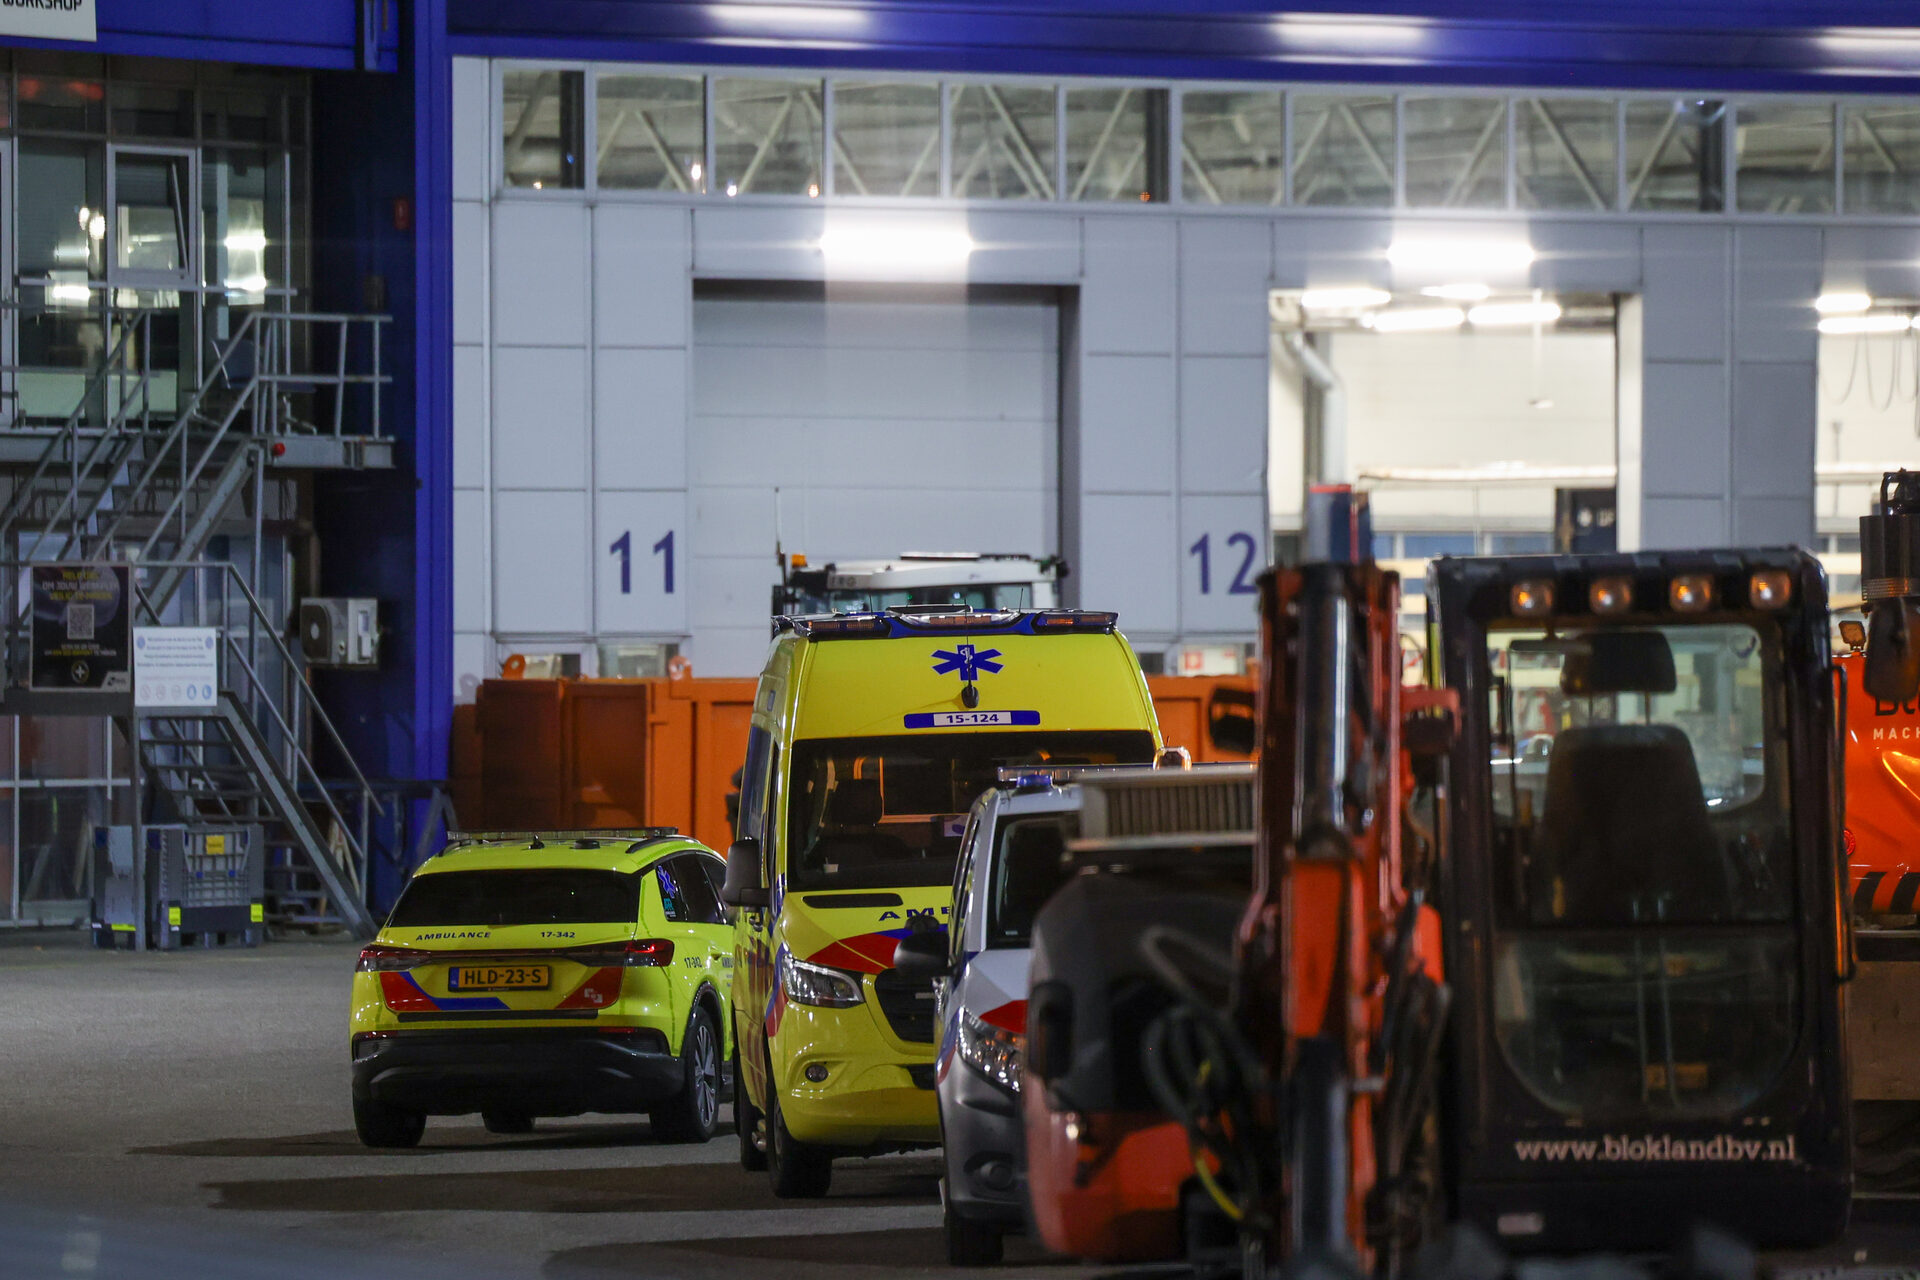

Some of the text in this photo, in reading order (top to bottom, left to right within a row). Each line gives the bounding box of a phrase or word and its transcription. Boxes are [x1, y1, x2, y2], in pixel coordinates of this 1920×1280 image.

[610, 530, 674, 594] 11
[1190, 531, 1258, 594] 12
[946, 713, 1000, 724] 15-124
[415, 931, 491, 942] AMBULANCE
[541, 931, 576, 939] 17-342
[464, 968, 542, 985] HLD-23-S
[1513, 1133, 1797, 1160] www.bloklandbv.nl
